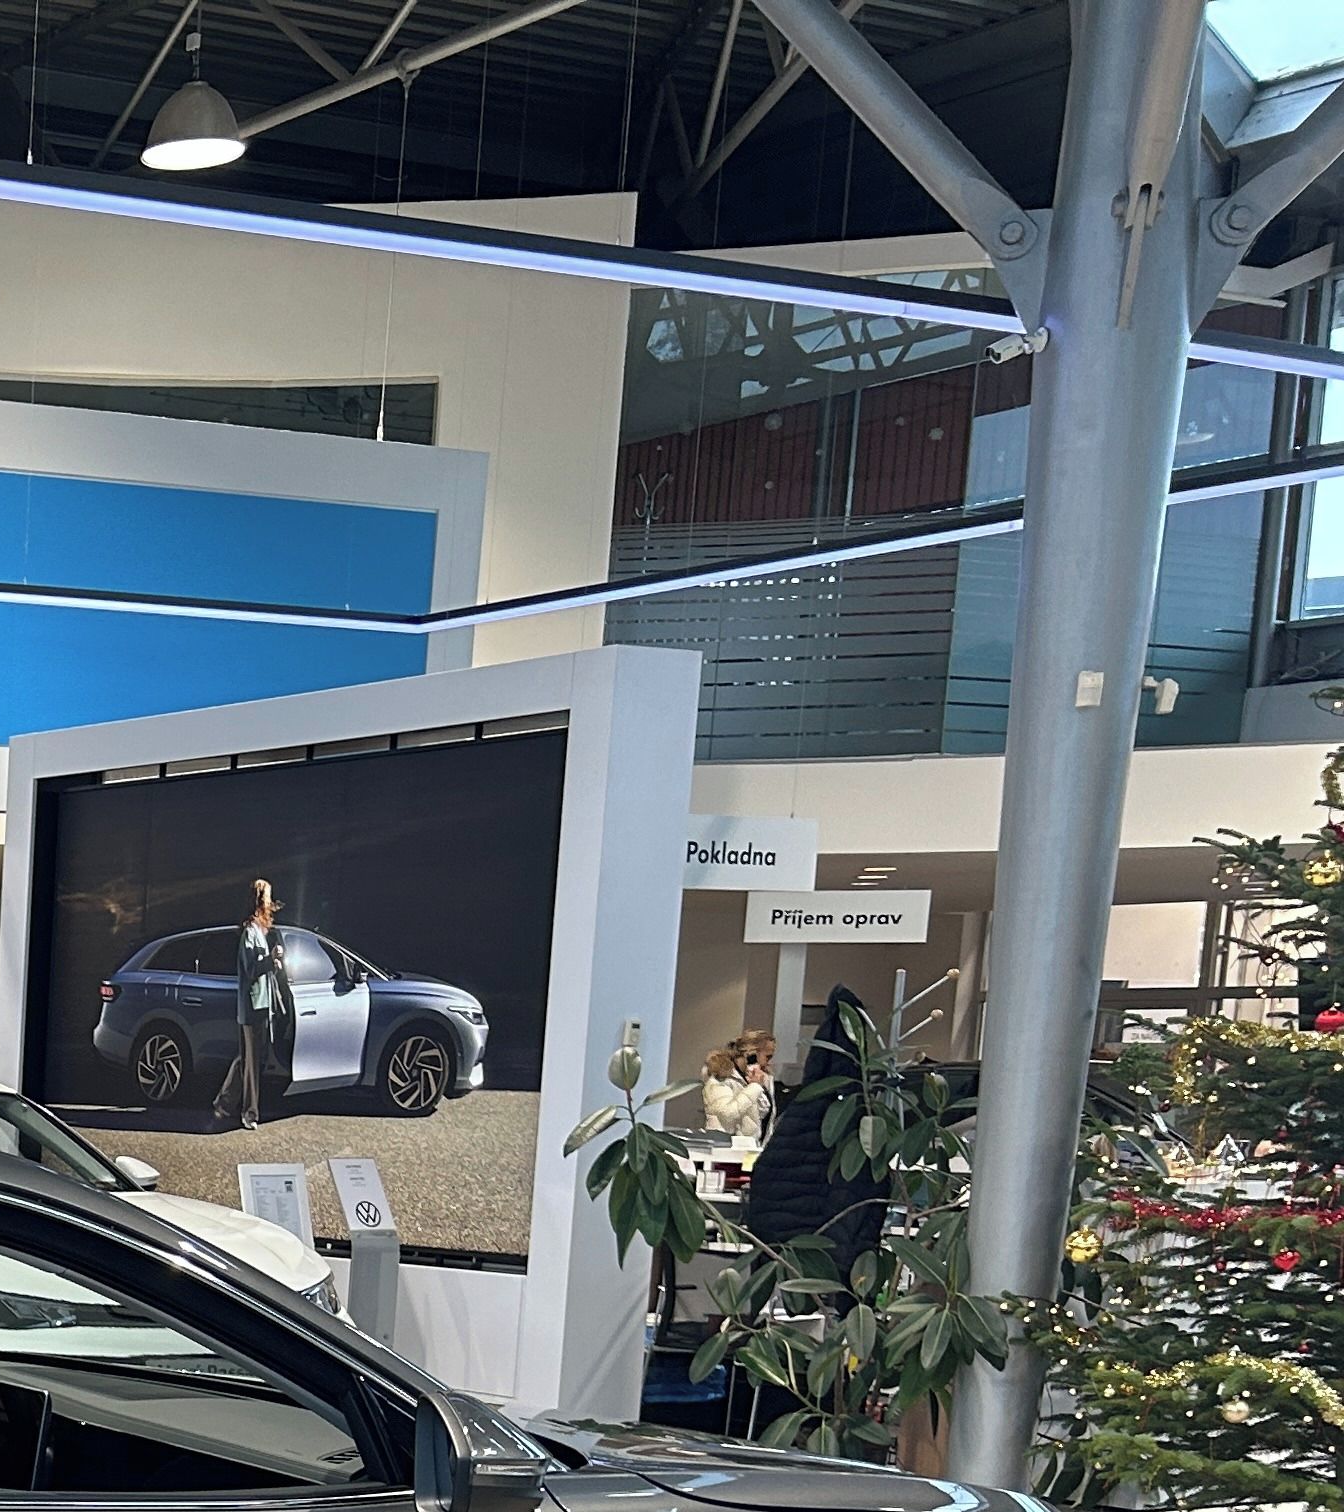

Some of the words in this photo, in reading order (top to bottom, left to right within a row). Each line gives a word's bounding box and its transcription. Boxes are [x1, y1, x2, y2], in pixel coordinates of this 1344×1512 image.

[686, 840, 776, 866] Pokladna
[771, 909, 834, 929] Příjem
[842, 913, 903, 929] oprav
